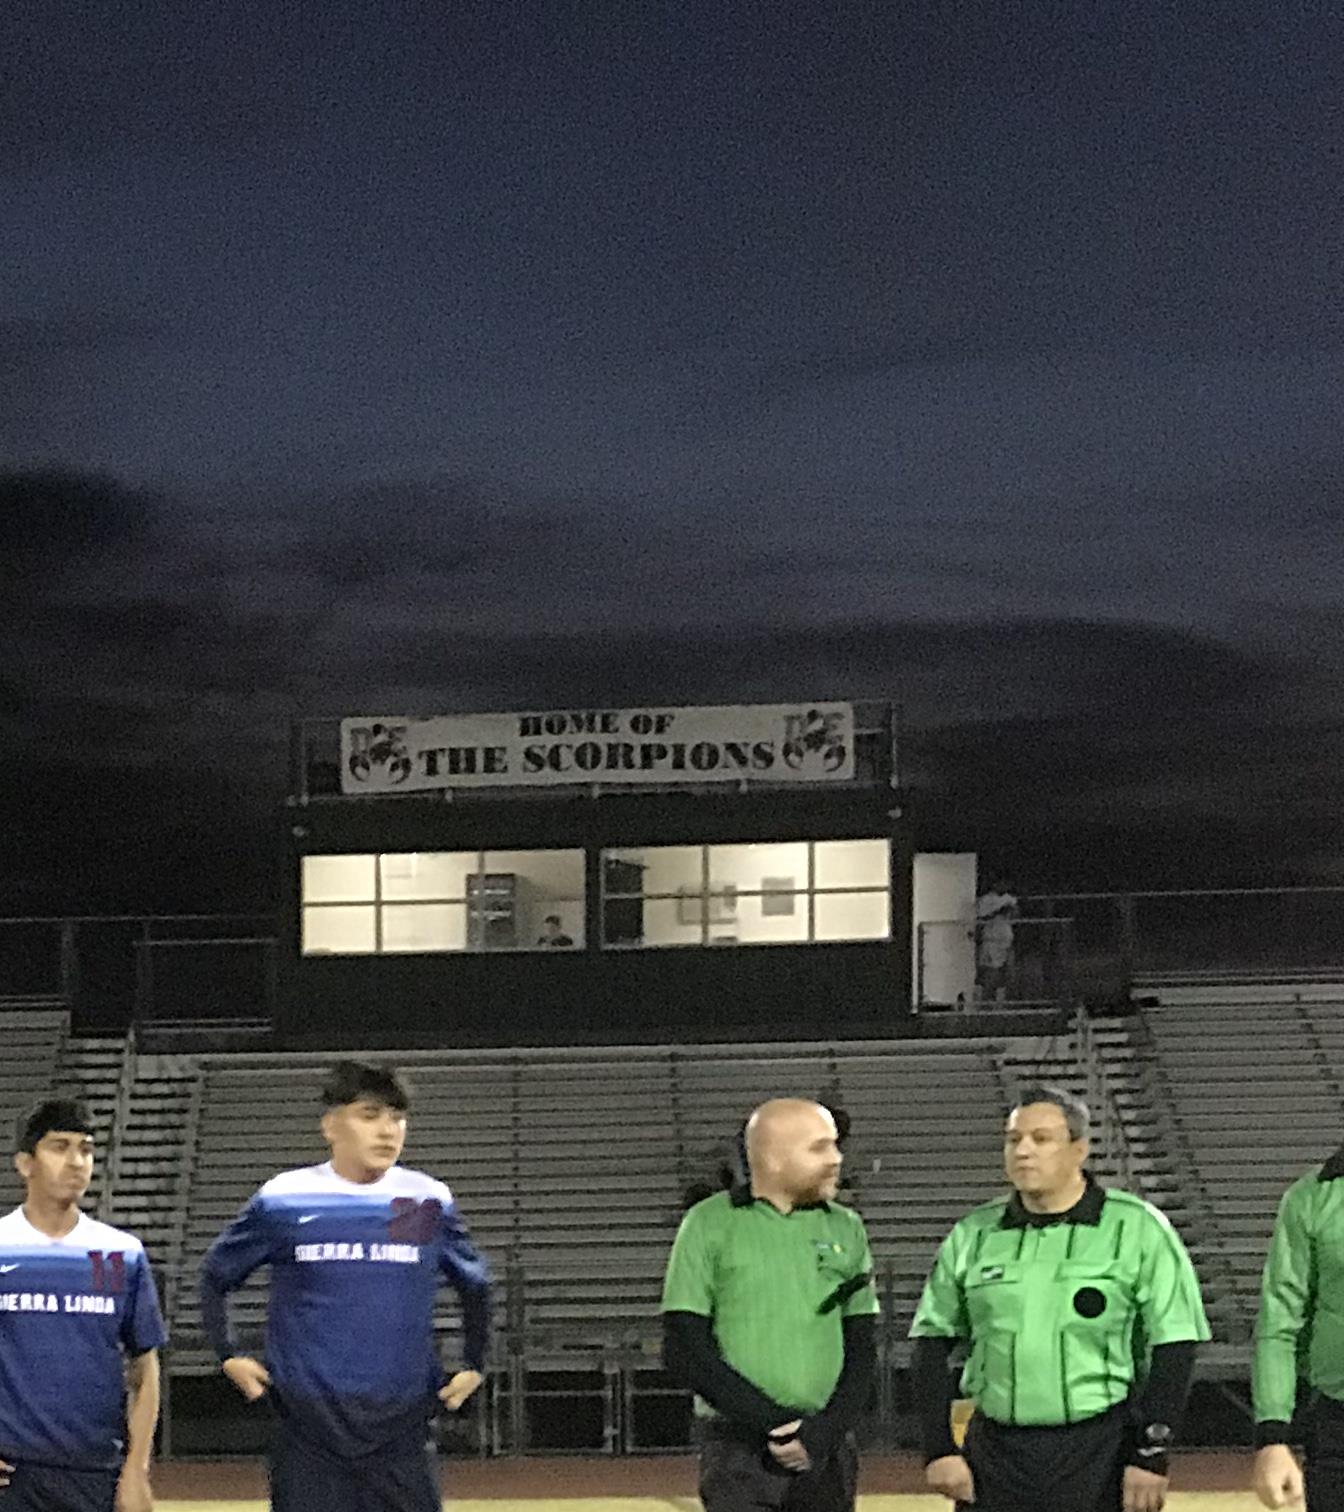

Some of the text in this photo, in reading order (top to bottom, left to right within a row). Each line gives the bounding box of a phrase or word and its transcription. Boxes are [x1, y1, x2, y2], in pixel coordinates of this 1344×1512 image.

[519, 712, 675, 737] HOME OF
[417, 740, 775, 777] THE SCORPIONS
[64, 1295, 115, 1314] LINDA
